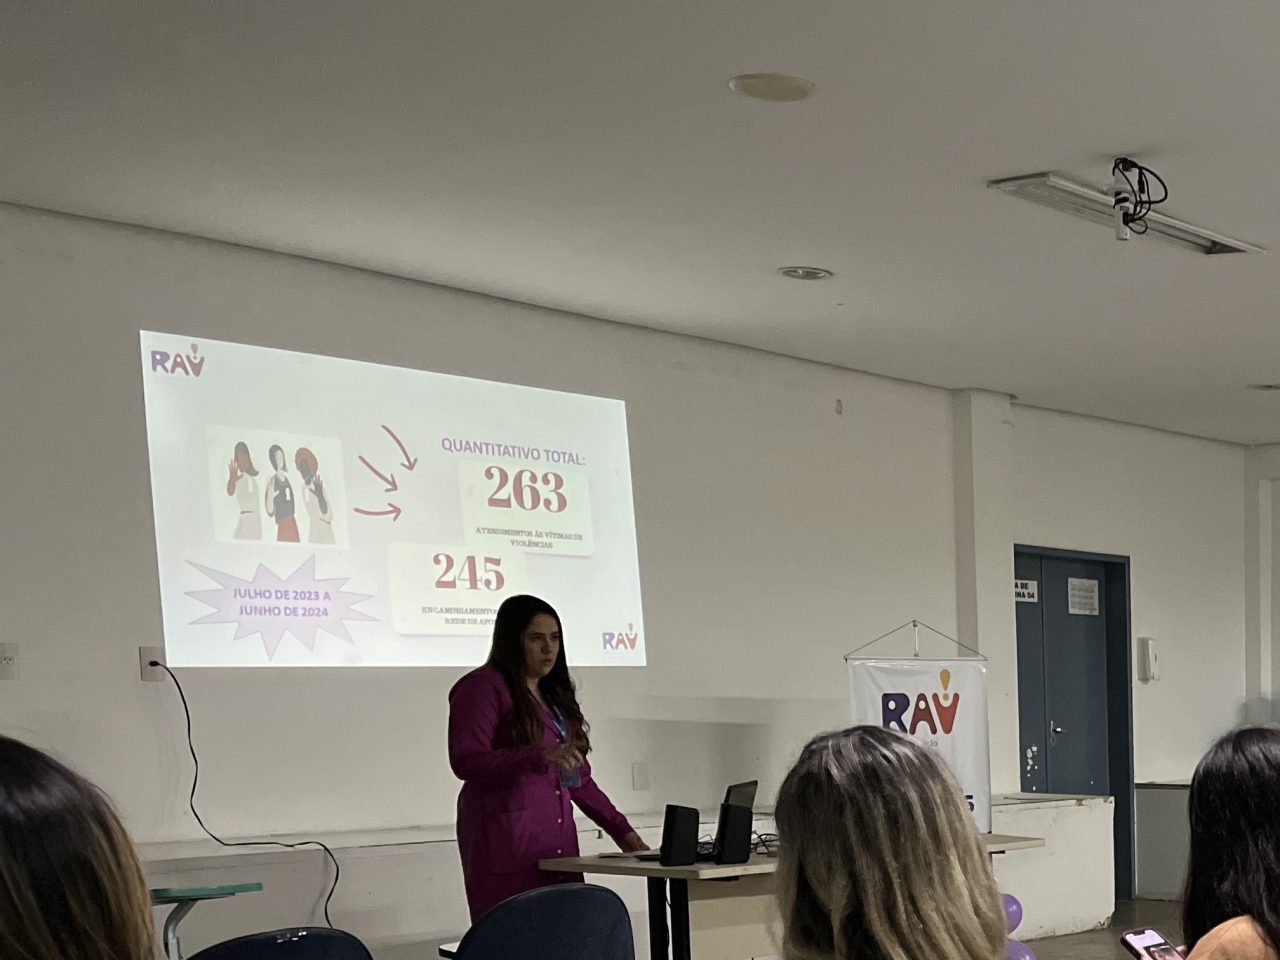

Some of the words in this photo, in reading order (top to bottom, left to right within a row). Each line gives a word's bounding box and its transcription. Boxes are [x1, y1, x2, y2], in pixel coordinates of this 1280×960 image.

[441, 437, 540, 461] QUANTITATIVO
[544, 449, 586, 466] TOTAL:
[484, 465, 568, 513] 263
[432, 552, 505, 592] 245
[233, 588, 272, 600] JULHO
[274, 589, 290, 600] DE
[292, 590, 320, 601] 2023
[322, 591, 332, 602] A
[239, 605, 282, 617] JUNHO
[284, 606, 299, 617] DE
[301, 607, 329, 618] 2024
[421, 606, 498, 616] ENCAMINHAMENTO
[881, 692, 960, 736] RAV
